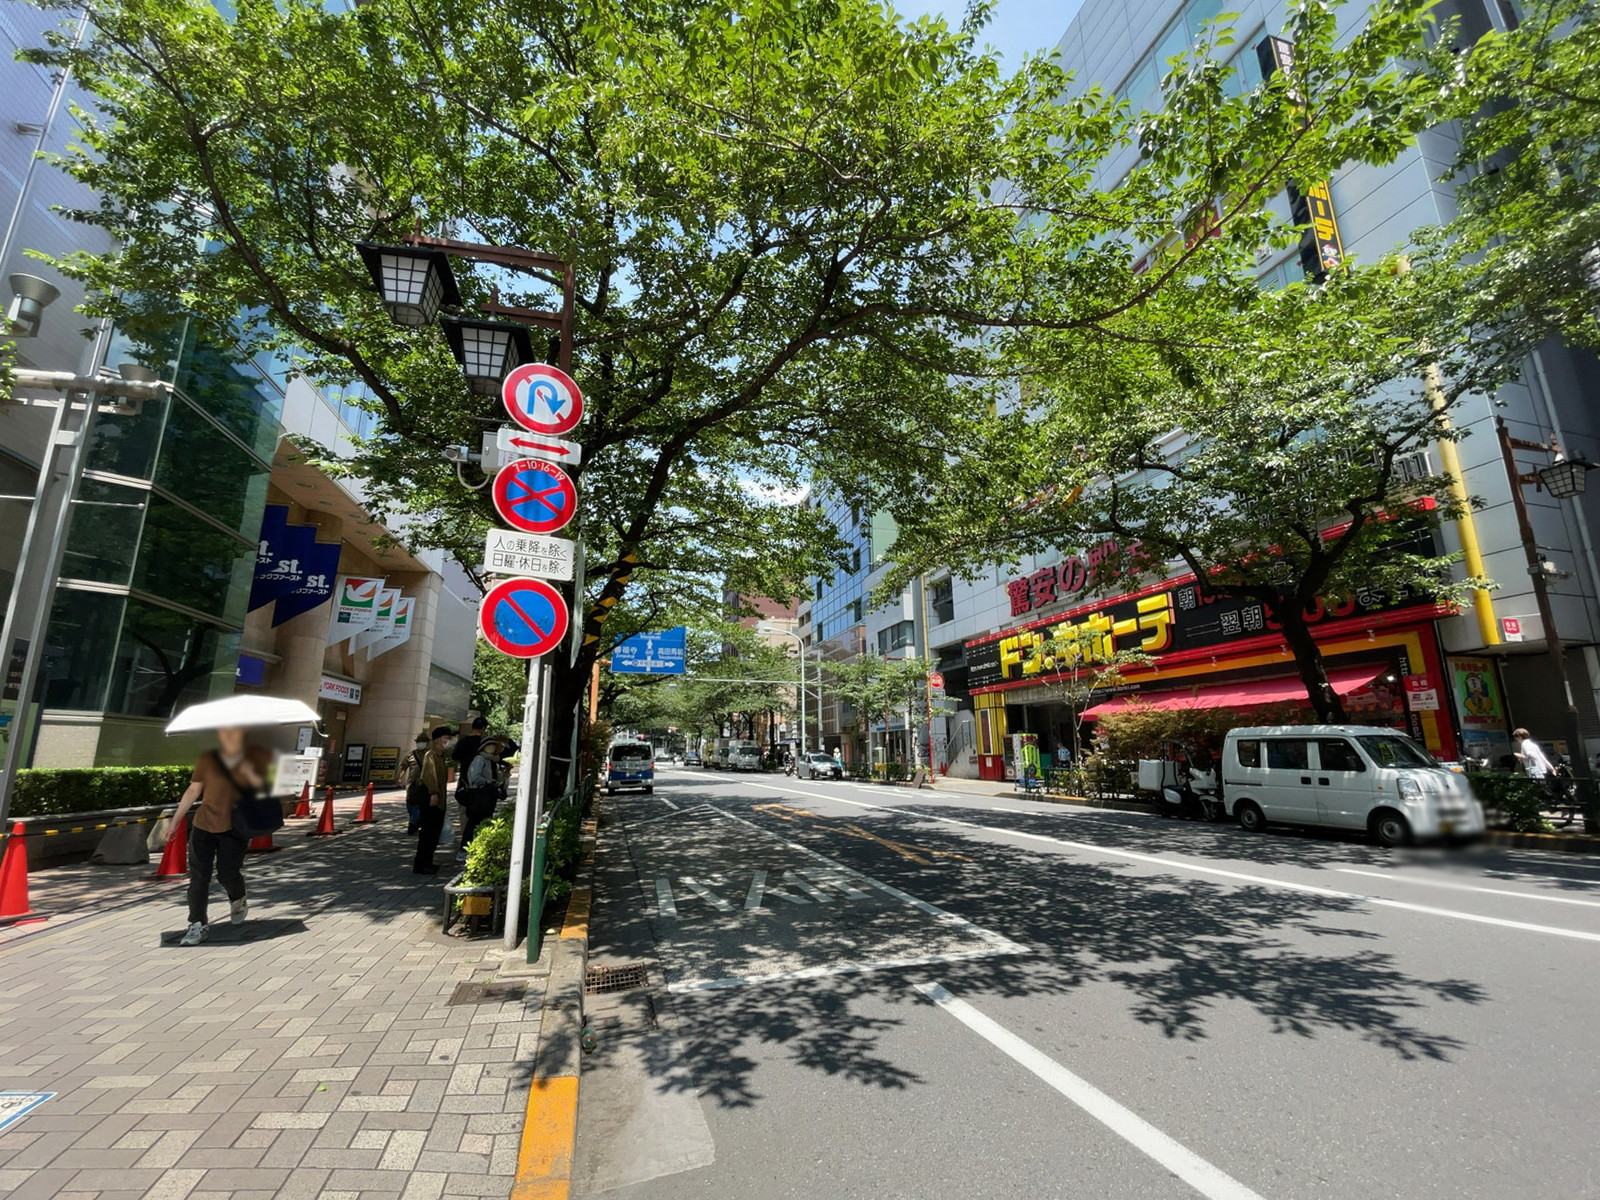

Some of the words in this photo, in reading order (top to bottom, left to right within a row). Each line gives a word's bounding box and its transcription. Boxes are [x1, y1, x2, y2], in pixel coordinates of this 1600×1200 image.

[493, 535, 568, 559] 人の乗降を除く
